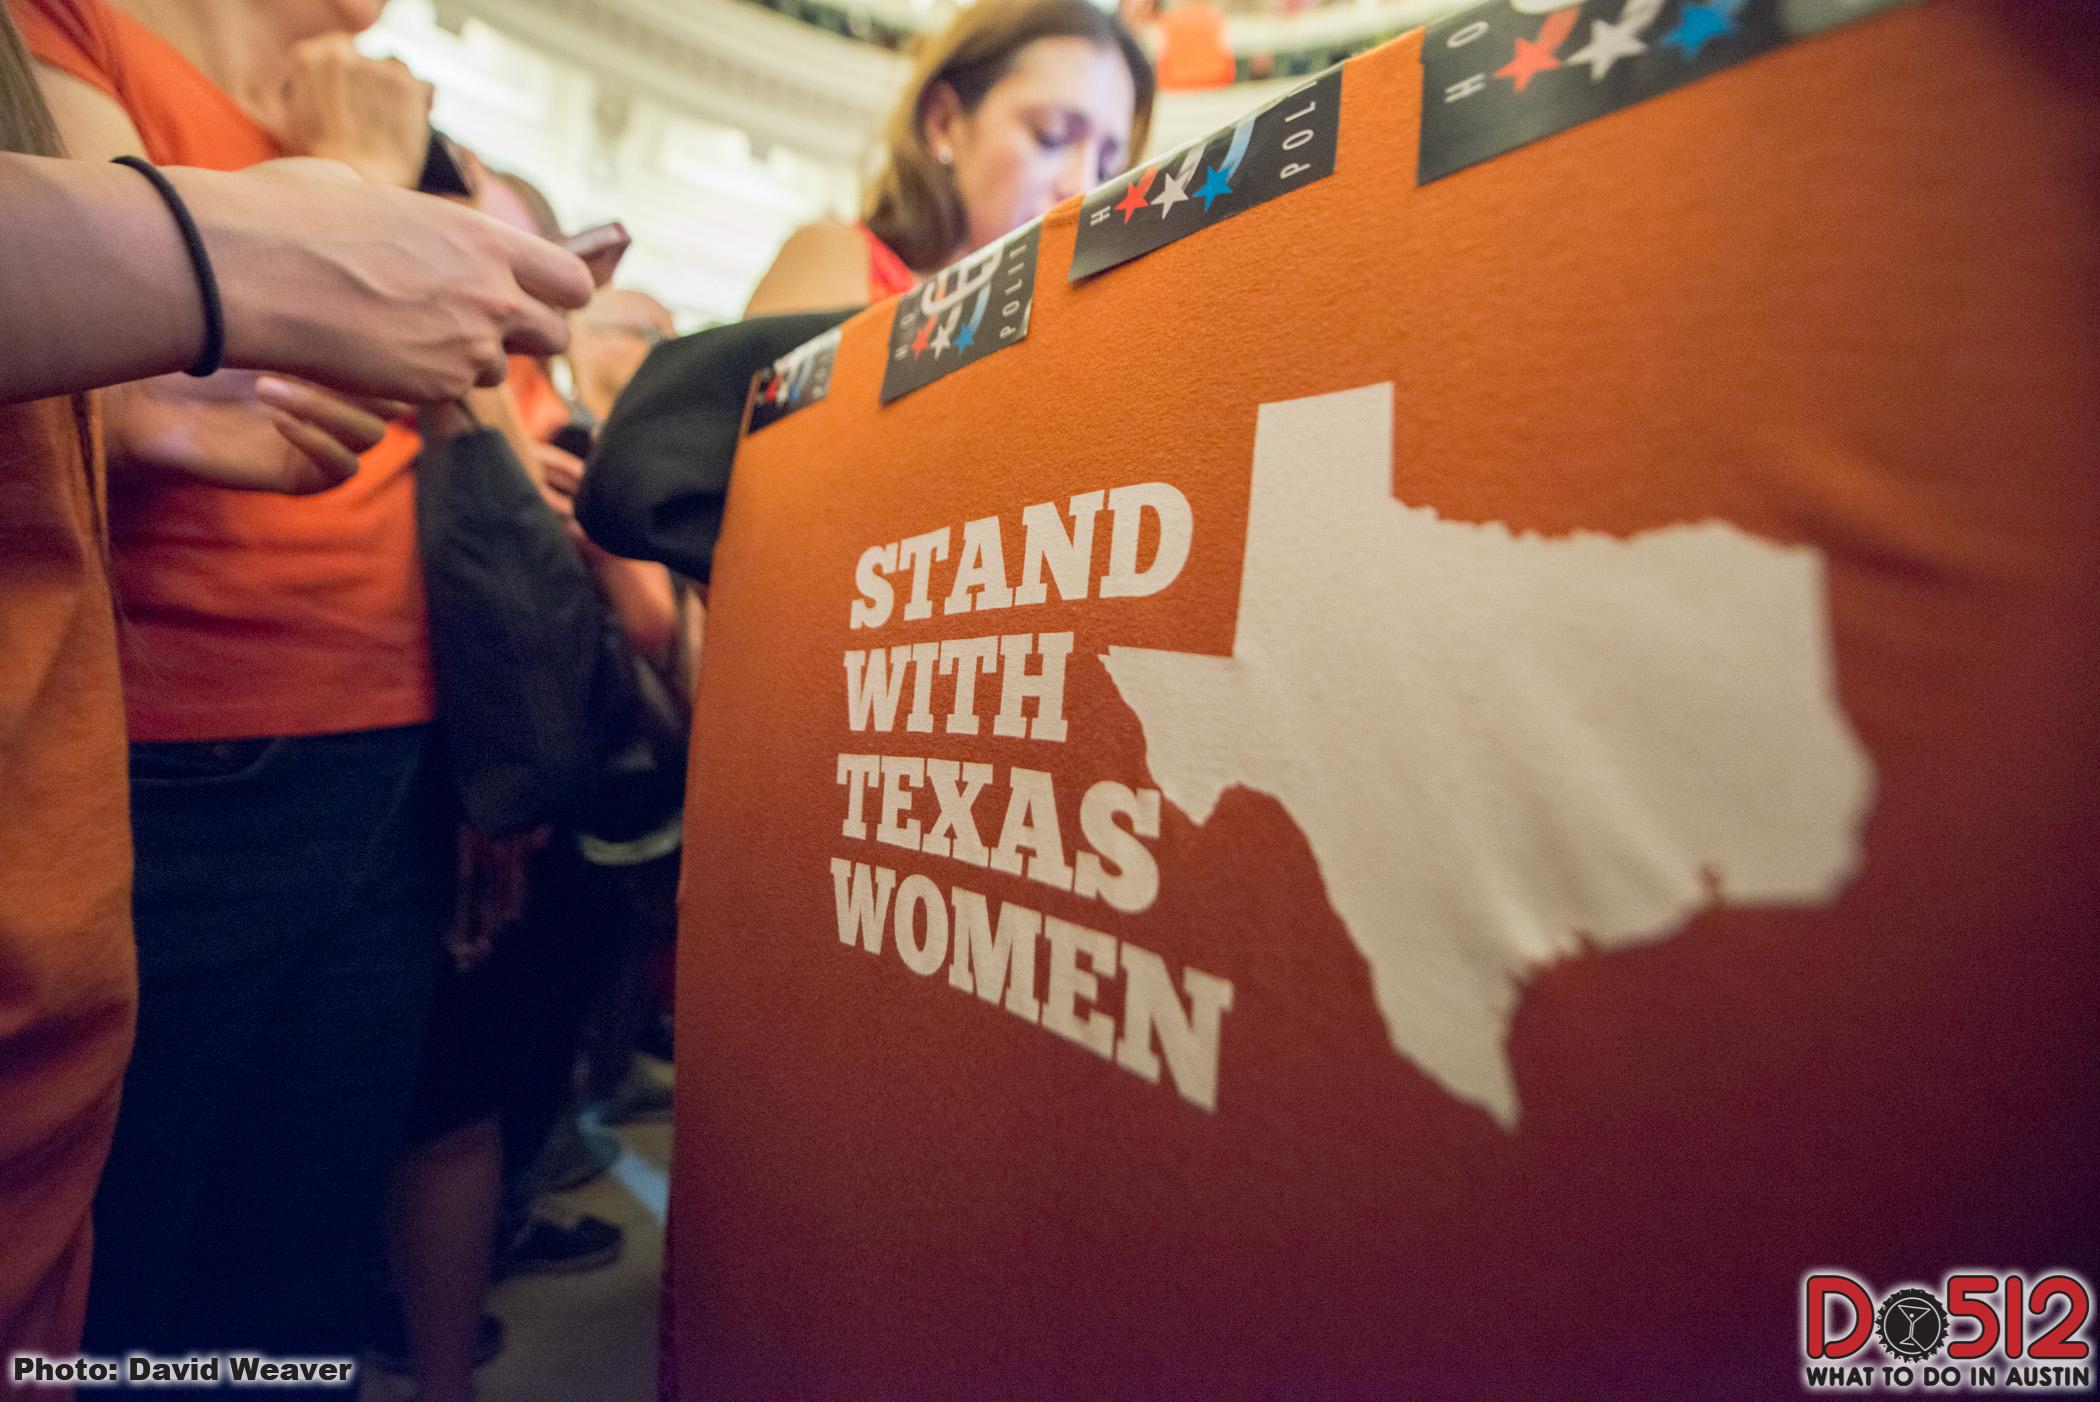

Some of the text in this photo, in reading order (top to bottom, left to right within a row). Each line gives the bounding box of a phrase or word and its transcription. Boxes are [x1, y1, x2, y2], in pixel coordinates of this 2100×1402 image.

[850, 481, 1194, 629] STAND
[844, 631, 1074, 743] WITH
[836, 753, 1161, 914] TEXAS
[830, 857, 1234, 1114] WOMEN
